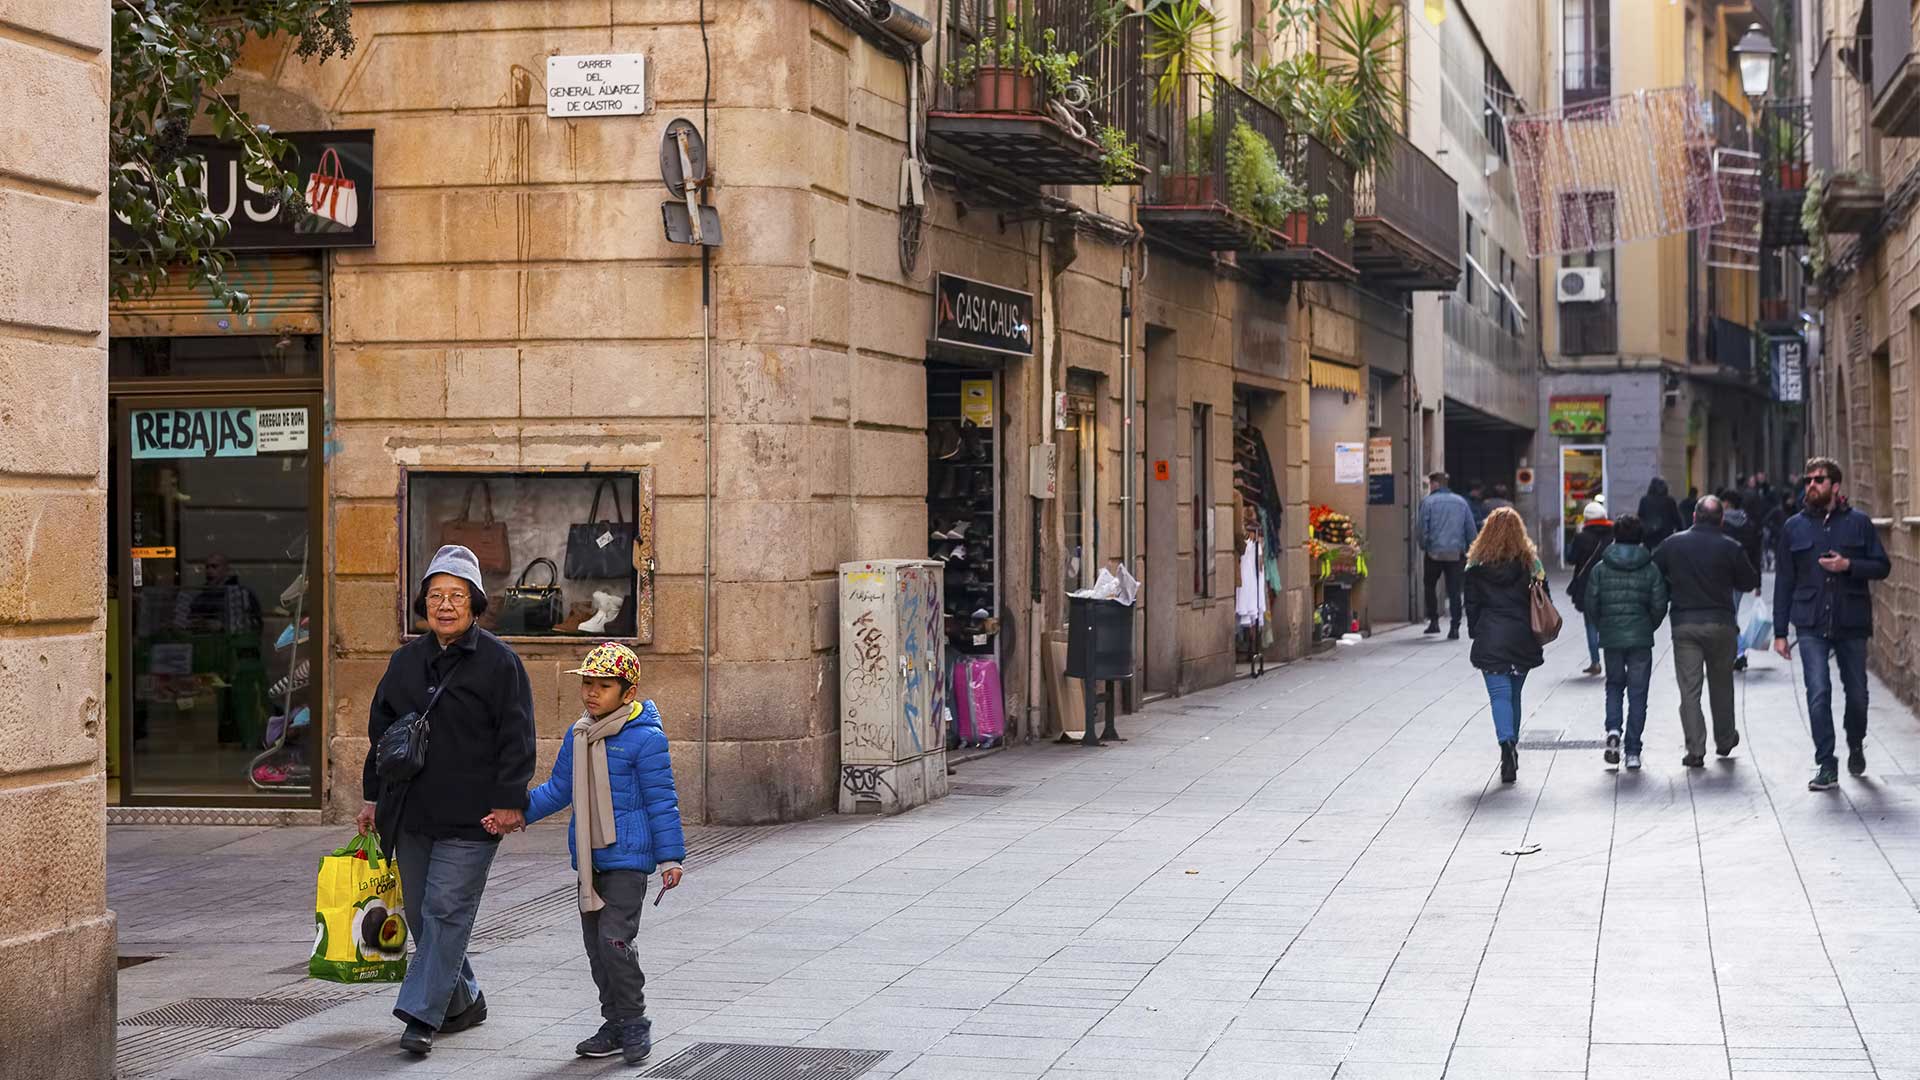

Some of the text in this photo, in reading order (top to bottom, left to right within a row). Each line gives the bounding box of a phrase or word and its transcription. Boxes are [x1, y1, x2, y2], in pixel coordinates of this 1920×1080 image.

[577, 59, 612, 69] CARRER
[586, 73, 603, 82] DEL
[549, 86, 595, 98] GENERAL
[567, 99, 623, 111] DE CASTRO
[956, 292, 1019, 340] CASA CAUS
[1786, 342, 1802, 401] RENTALS
[258, 411, 304, 427] ARREGLO DE ROPA
[135, 410, 254, 457] REBAJAS
[359, 881, 369, 891] La
